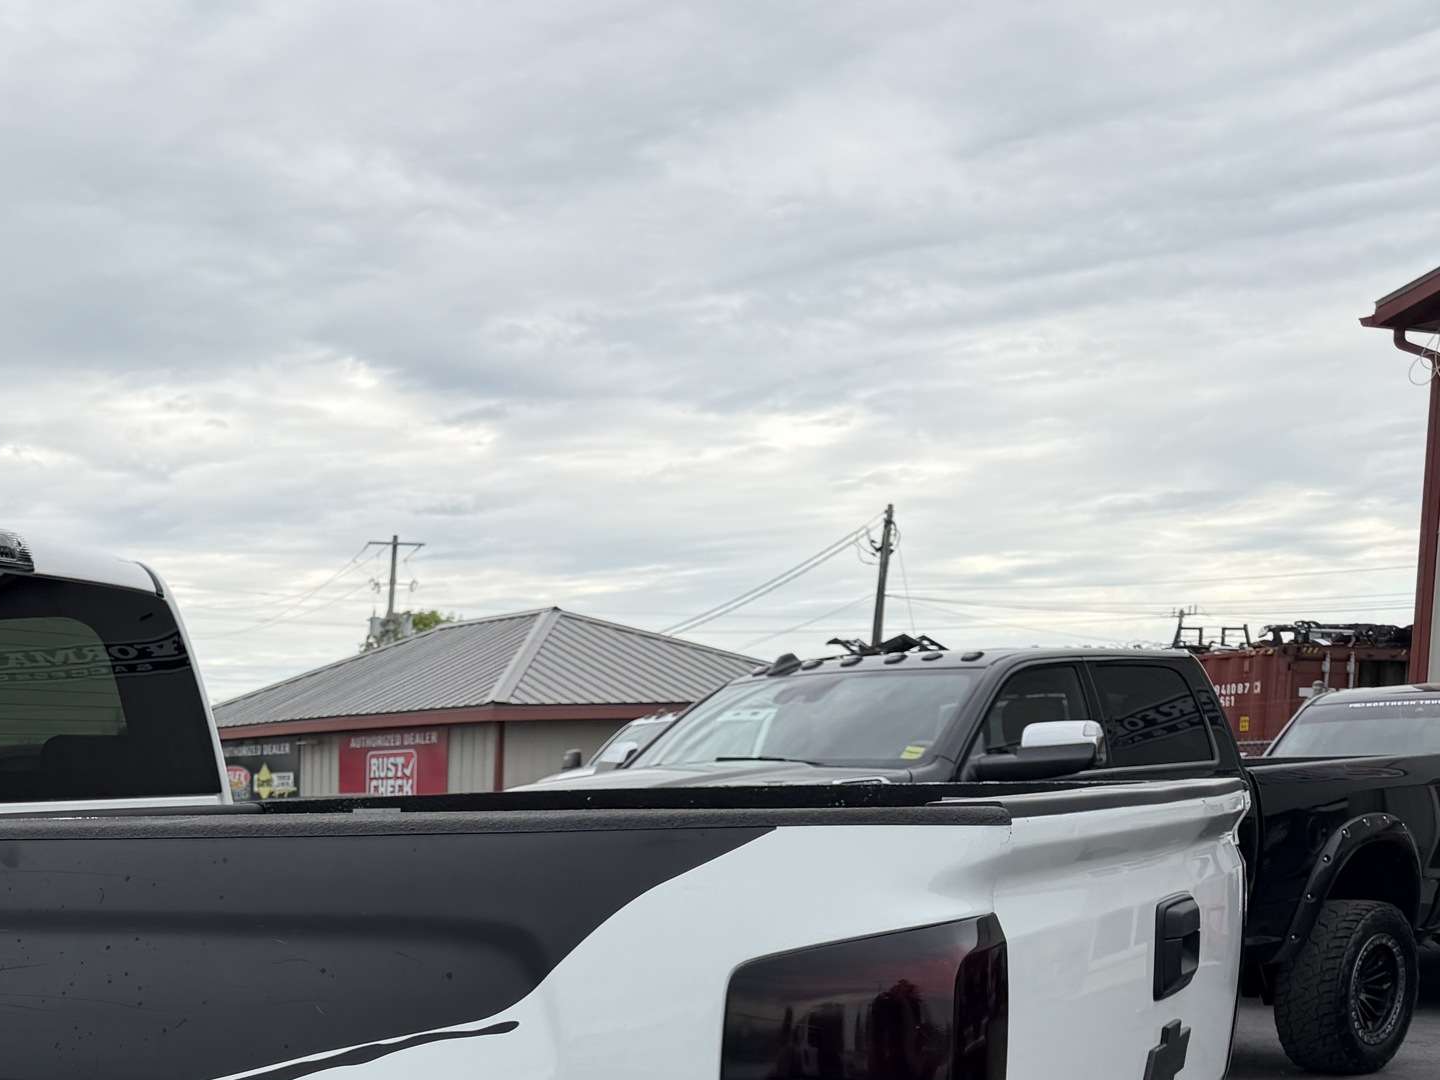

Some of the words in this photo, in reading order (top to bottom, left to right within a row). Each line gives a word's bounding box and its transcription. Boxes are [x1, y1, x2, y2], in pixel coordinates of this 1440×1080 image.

[350, 733, 402, 749] AUTHORIZED
[403, 731, 438, 746] DEALER
[370, 755, 405, 778] RUST
[370, 778, 412, 796] CHECK
